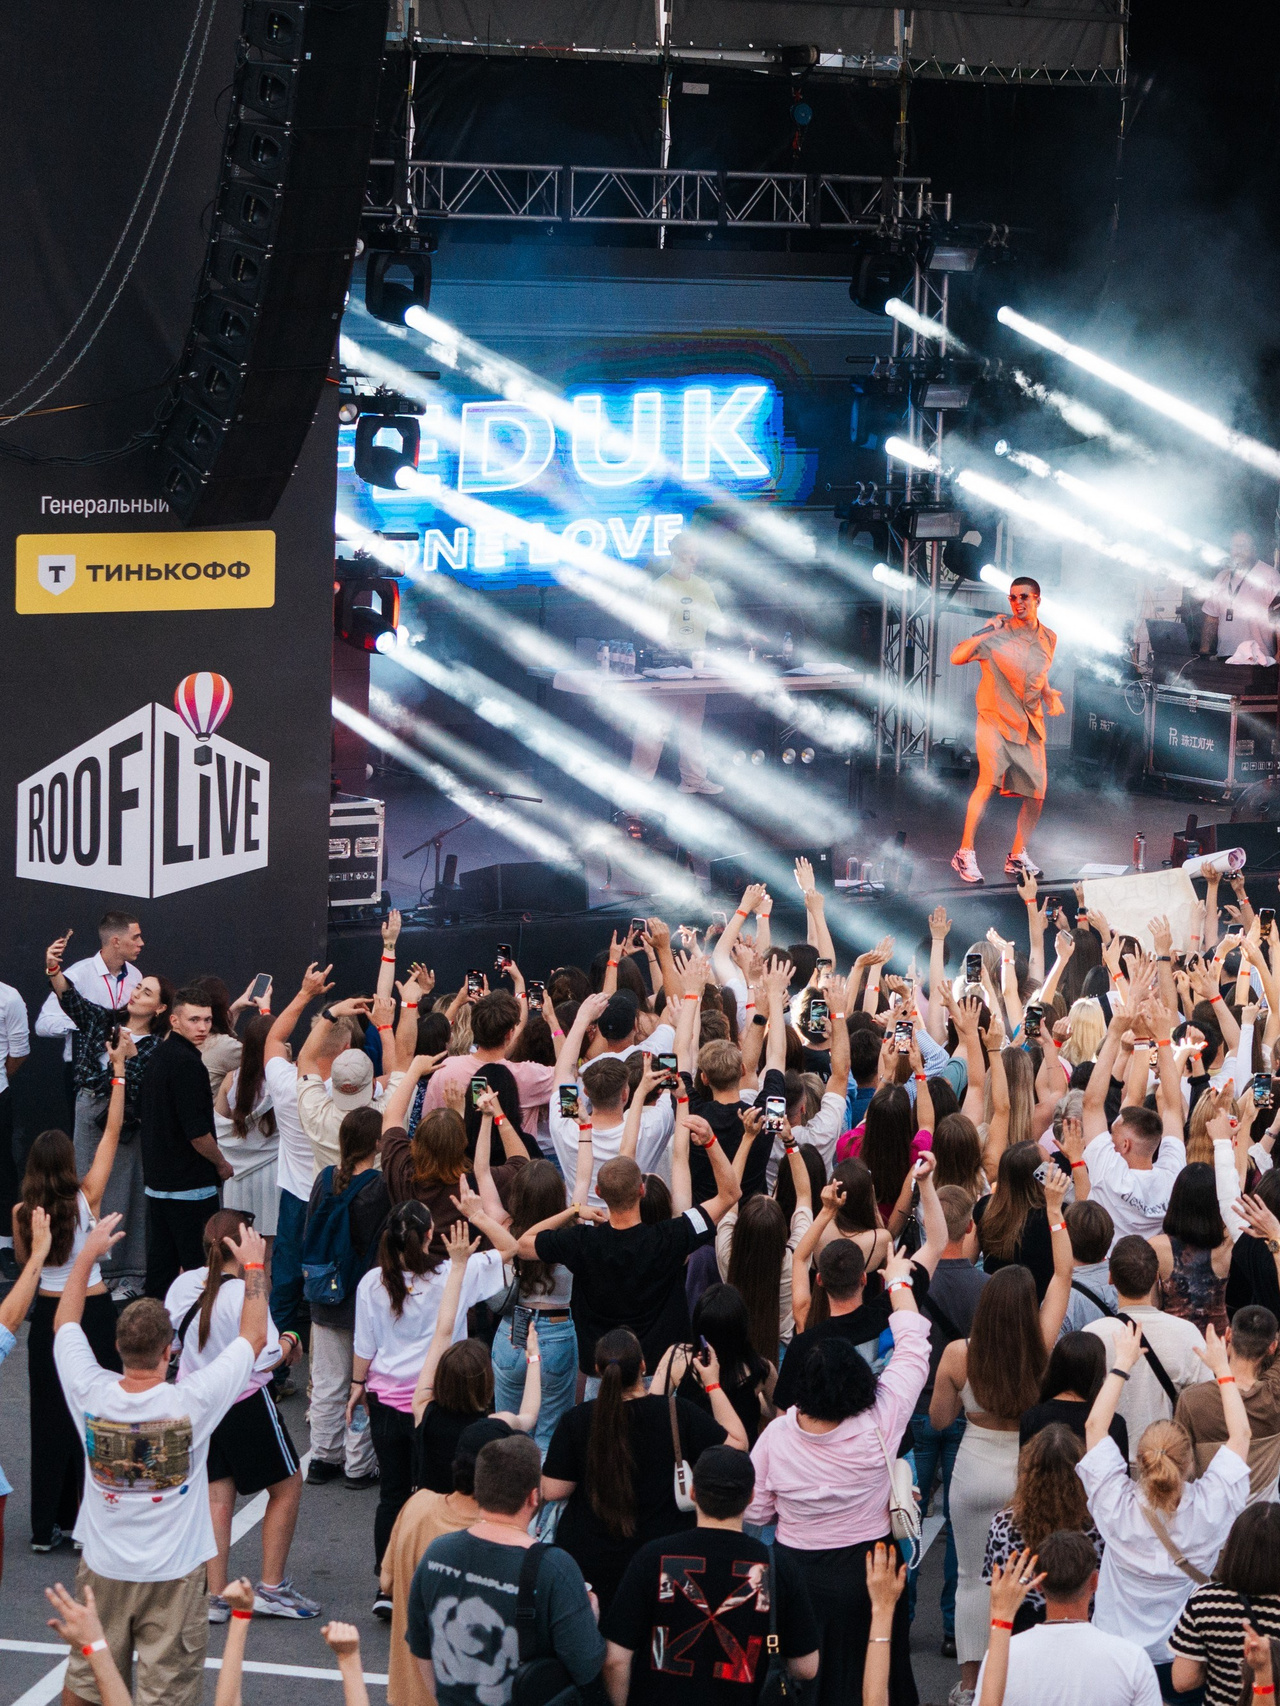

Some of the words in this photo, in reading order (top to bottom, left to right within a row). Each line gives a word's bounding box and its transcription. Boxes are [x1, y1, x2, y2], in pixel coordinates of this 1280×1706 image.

[527, 513, 685, 565] LOVE
[85, 560, 251, 583] ТИНЬКОФФ
[28, 731, 144, 867] ROOF
